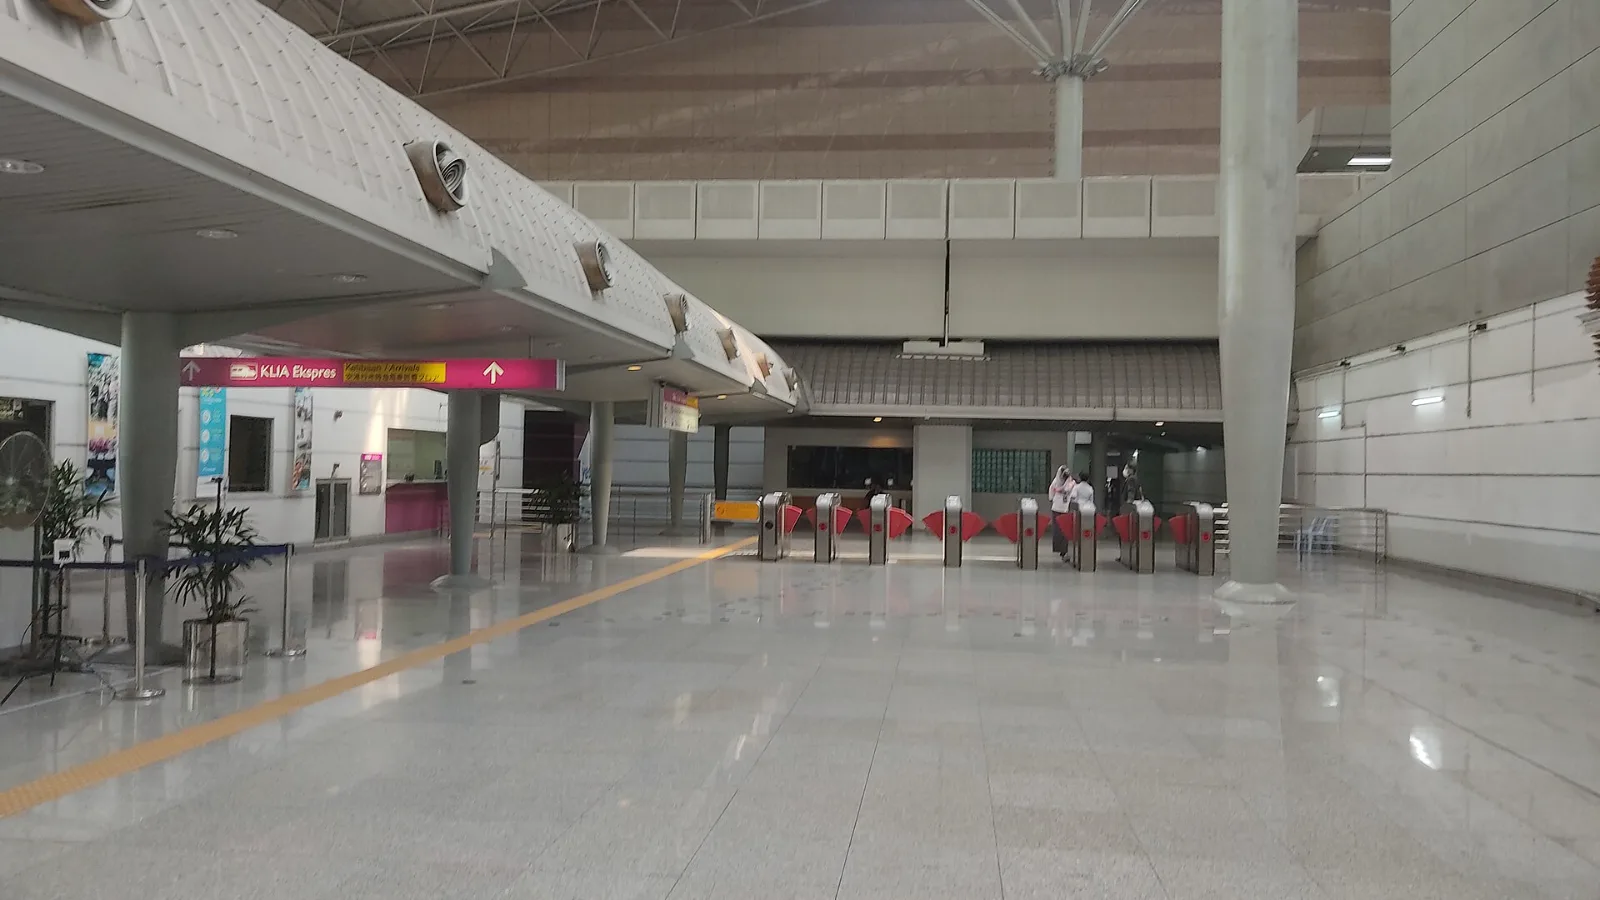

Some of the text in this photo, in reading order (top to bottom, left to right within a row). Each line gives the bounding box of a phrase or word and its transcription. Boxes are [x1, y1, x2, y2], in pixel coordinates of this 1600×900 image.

[260, 364, 290, 378] KLIA
[292, 364, 337, 382] Ekspres
[388, 363, 420, 372] Arrivals
